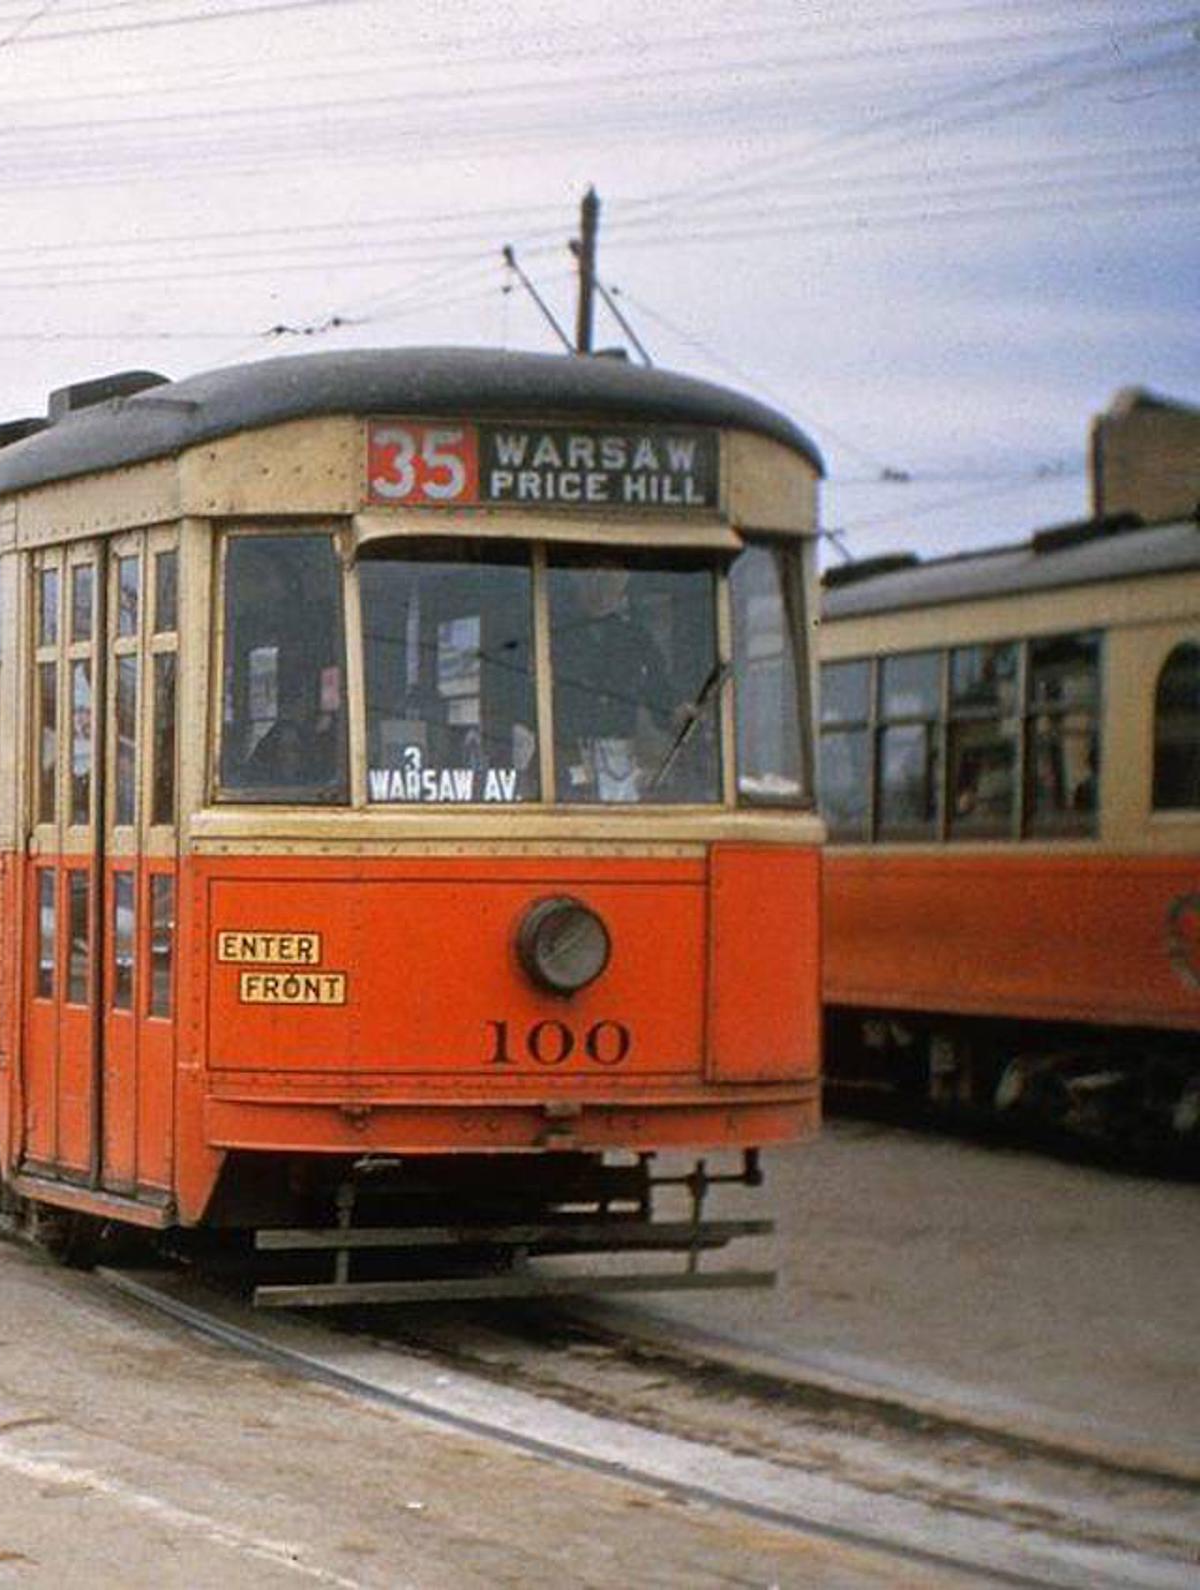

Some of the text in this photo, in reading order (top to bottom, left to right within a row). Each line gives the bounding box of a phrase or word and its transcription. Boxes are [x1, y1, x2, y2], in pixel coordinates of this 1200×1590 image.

[371, 428, 466, 498] 35
[494, 433, 697, 472] WARSAW
[490, 470, 705, 503] PRICE HILL
[369, 768, 474, 801] WARSAW
[223, 935, 314, 961] ENTER
[246, 976, 340, 1000] FRONT
[481, 1018, 631, 1066] 100
